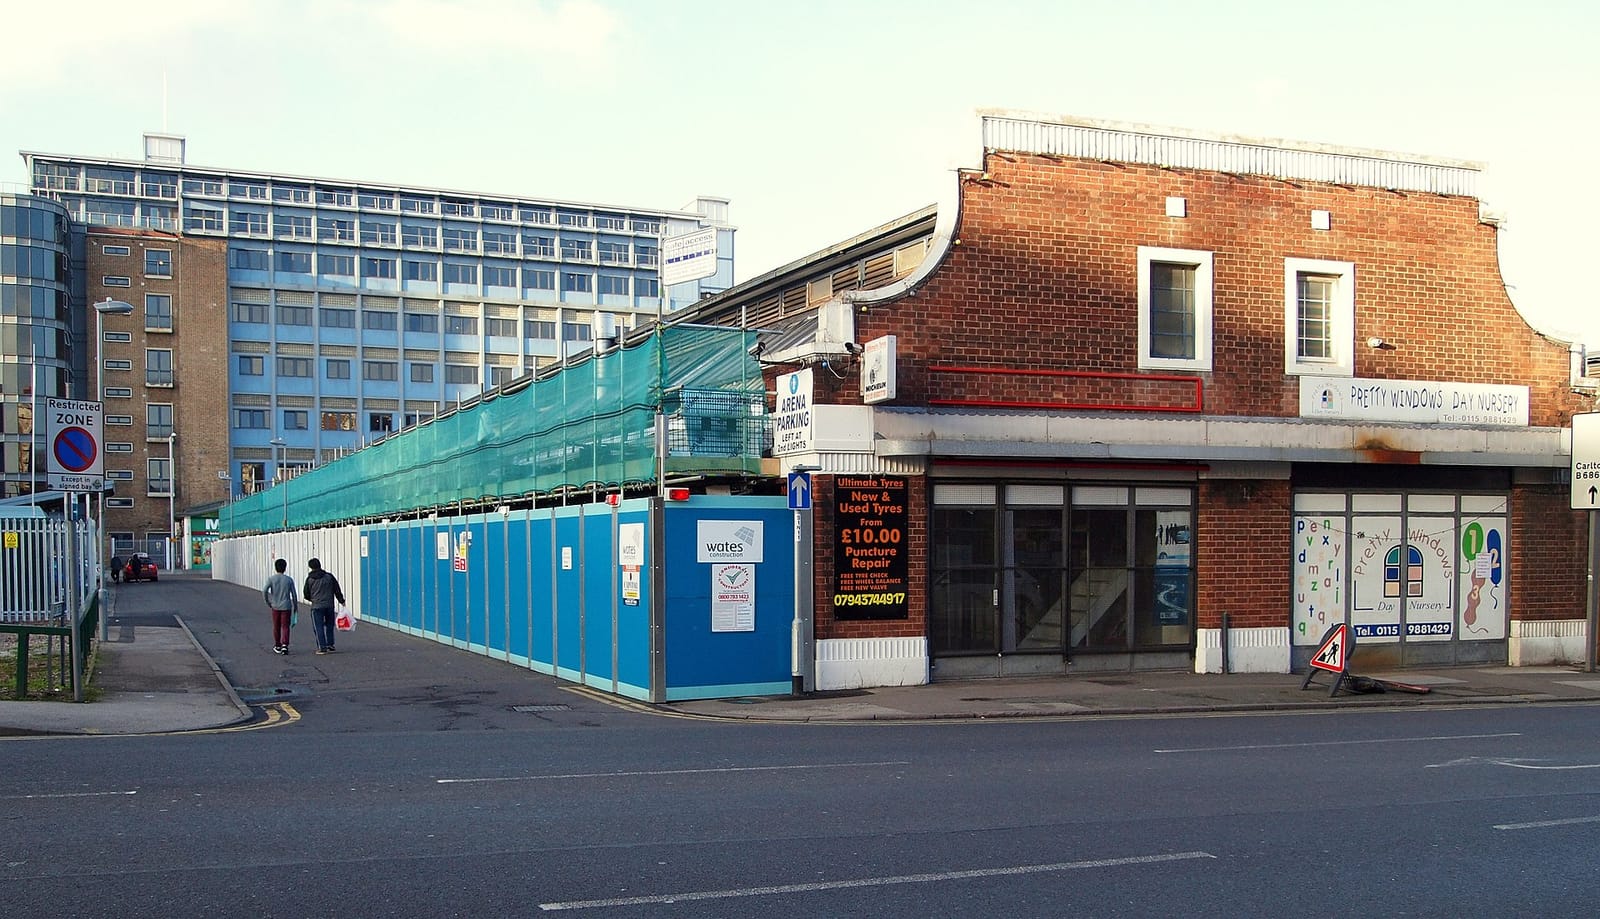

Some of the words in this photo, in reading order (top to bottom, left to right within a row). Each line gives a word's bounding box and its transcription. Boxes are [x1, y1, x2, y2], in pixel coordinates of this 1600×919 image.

[49, 400, 100, 411] Restricted
[781, 394, 806, 413] ARENA
[1351, 386, 1386, 408] PRETTY
[1391, 388, 1443, 409] WINDOWS
[1453, 392, 1474, 410] DAY
[1478, 393, 1518, 413] NURSERY
[57, 414, 93, 425] ZONE
[777, 411, 809, 432] PARKING
[782, 432, 794, 442] LEFT
[778, 444, 786, 453] 2nd
[787, 441, 806, 450] LIGHTS
[61, 476, 82, 484] Except
[838, 478, 877, 487] Ultimate
[880, 479, 904, 489] Tyres
[851, 491, 878, 501] New
[882, 491, 891, 501] &
[840, 503, 869, 513] Used
[873, 503, 902, 515] Tyres
[842, 529, 900, 544] £10.00
[1470, 530, 1476, 554] 1
[707, 542, 743, 552] wates
[846, 547, 897, 557] Puncture
[1355, 529, 1390, 575] Pretty
[1408, 528, 1452, 578] Windows
[852, 558, 890, 570] Repair
[1491, 548, 1500, 568] 2
[1472, 585, 1479, 599] 3
[834, 593, 905, 606] 07943744917
[1378, 602, 1395, 613] Day
[1409, 601, 1444, 612] Nursery
[1356, 627, 1373, 636] Tel.
[1377, 627, 1397, 635] 0115
[1408, 625, 1449, 634] 9881429
